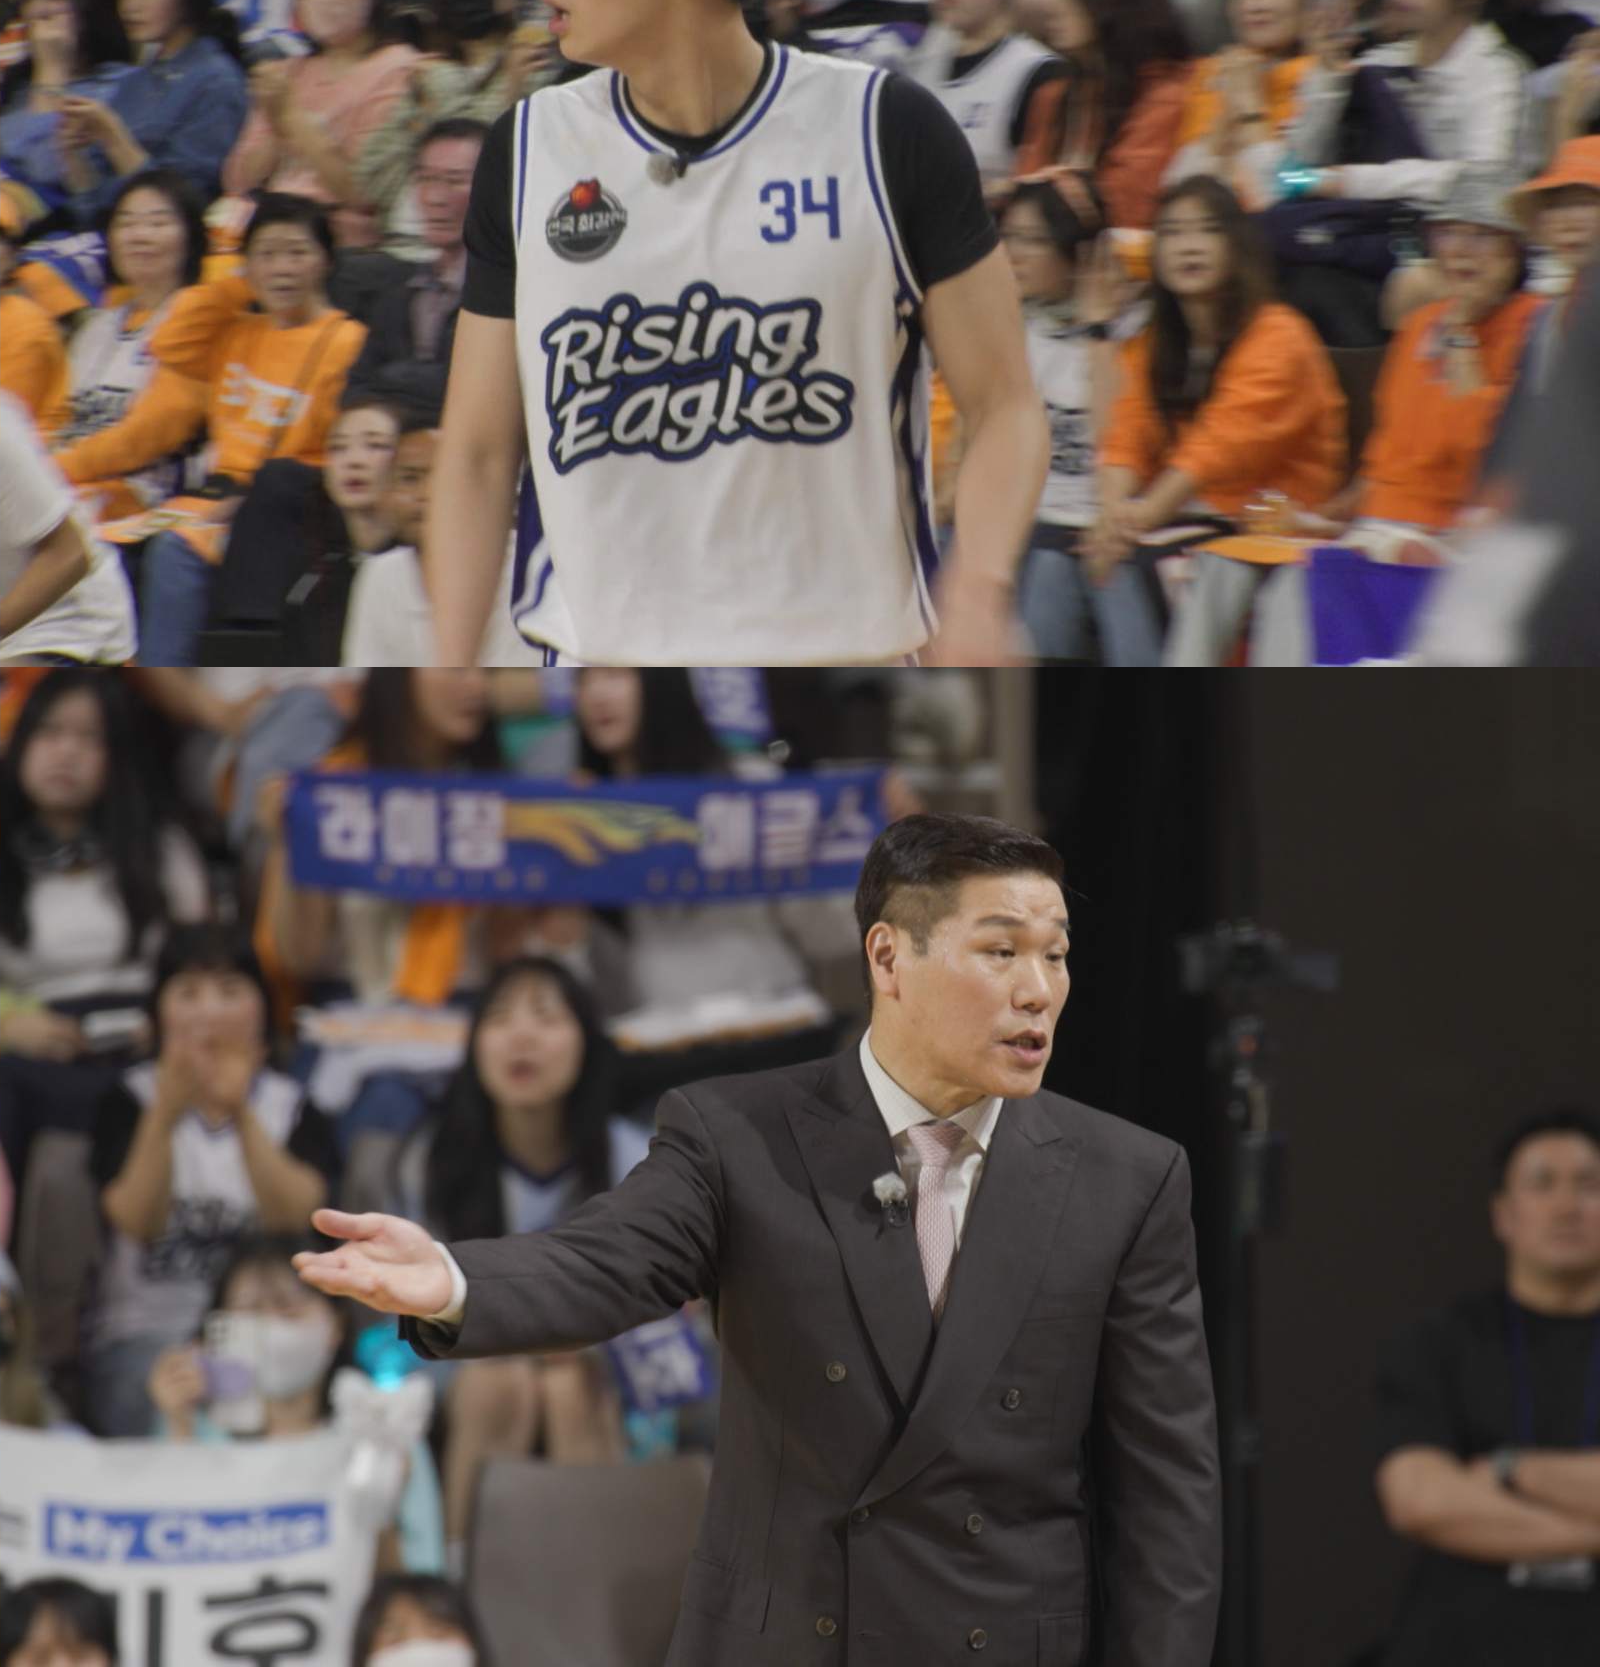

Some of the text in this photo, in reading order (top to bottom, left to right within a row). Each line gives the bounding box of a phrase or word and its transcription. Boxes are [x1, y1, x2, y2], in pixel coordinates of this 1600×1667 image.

[759, 175, 841, 245] 34
[544, 286, 816, 407] Rising
[552, 364, 850, 467] Eagles
